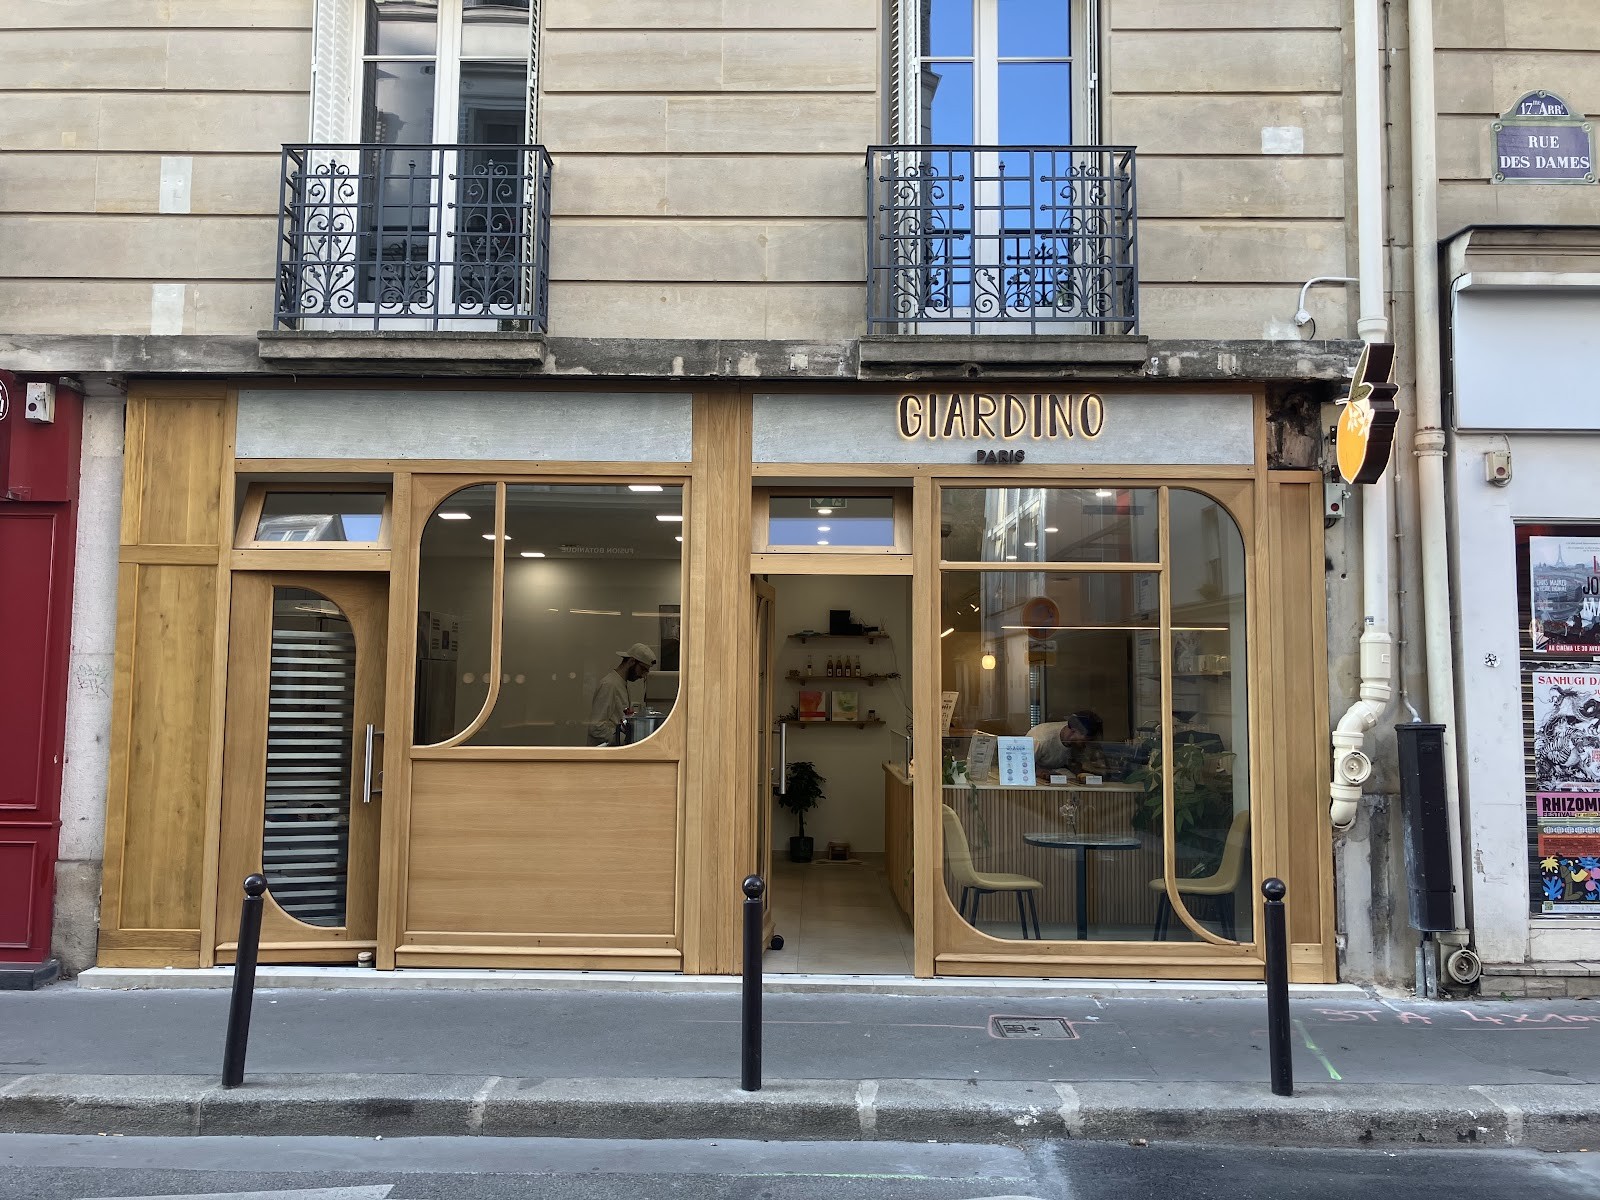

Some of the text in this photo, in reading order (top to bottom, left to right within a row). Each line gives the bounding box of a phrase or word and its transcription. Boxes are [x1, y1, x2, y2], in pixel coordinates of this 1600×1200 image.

[1528, 136, 1560, 148] RUE
[1500, 156, 1590, 168] DES DAMES
[900, 394, 1104, 437] GIARDINO
[976, 450, 1026, 463] PARIS
[1538, 676, 1584, 685] SANHUGI
[1542, 798, 1600, 811] RHIZOM
